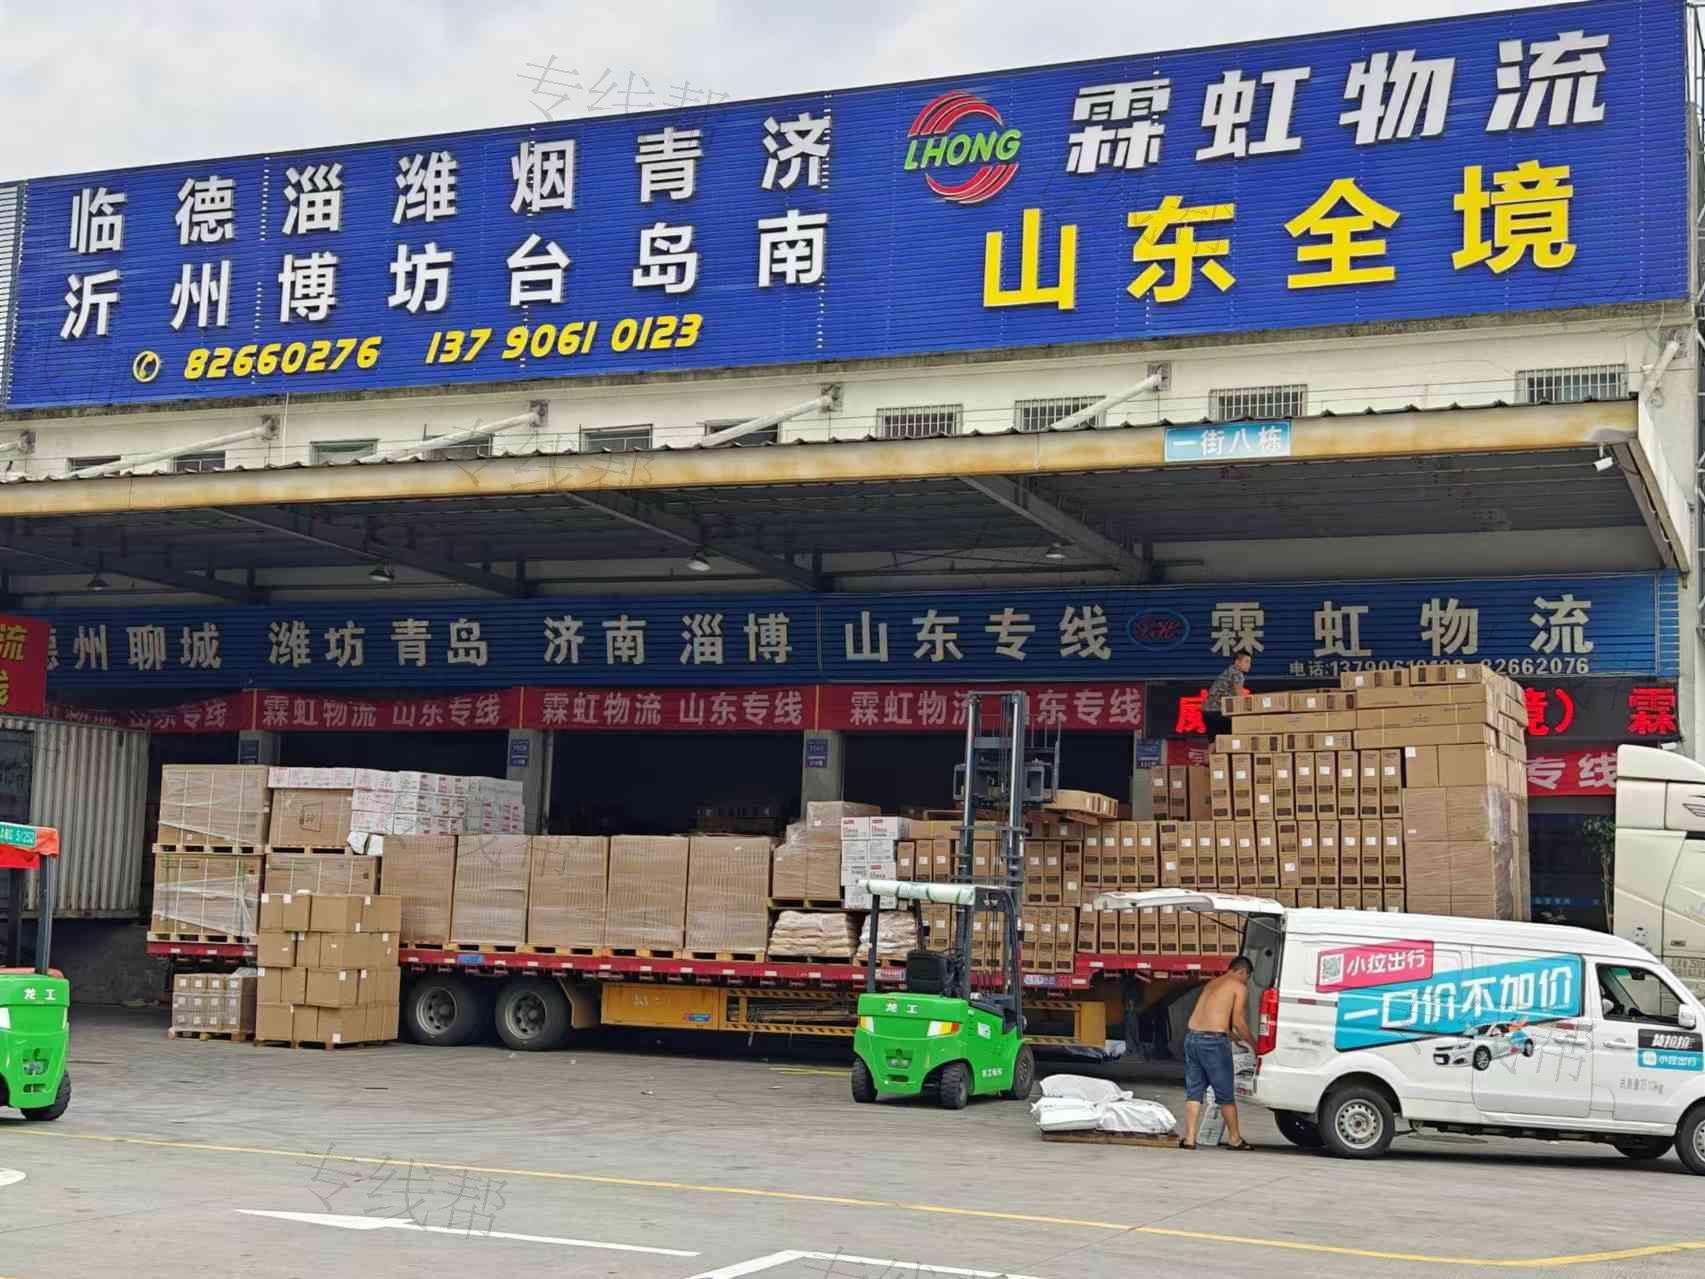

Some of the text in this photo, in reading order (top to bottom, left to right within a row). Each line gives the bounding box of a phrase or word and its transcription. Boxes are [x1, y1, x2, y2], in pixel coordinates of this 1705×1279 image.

[1066, 29, 1610, 174] 霖虹物流
[903, 128, 1022, 170] LHONG
[388, 151, 457, 313] 潍坊
[506, 139, 576, 307] 烟台
[632, 127, 702, 294] 青岛
[757, 113, 830, 288] 济南
[60, 187, 126, 339] 临沂
[169, 176, 235, 331] 德州
[278, 164, 342, 323] 淄博
[983, 160, 1577, 312] 山东全境
[184, 313, 704, 381] 82660276 137 9061 0123
[267, 618, 488, 667] 潍坊青岛
[844, 604, 1112, 662] 山东专线
[1210, 594, 1593, 657] 霖虹物流
[262, 692, 502, 728] 霖虹物流 山东专线
[543, 692, 803, 726] 霖虹物流 山东专线
[1627, 687, 1677, 735] 霖
[1525, 752, 1616, 790] 专线
[1346, 949, 1425, 976] 小拉出行
[1343, 967, 1573, 1029] 一口价不加价
